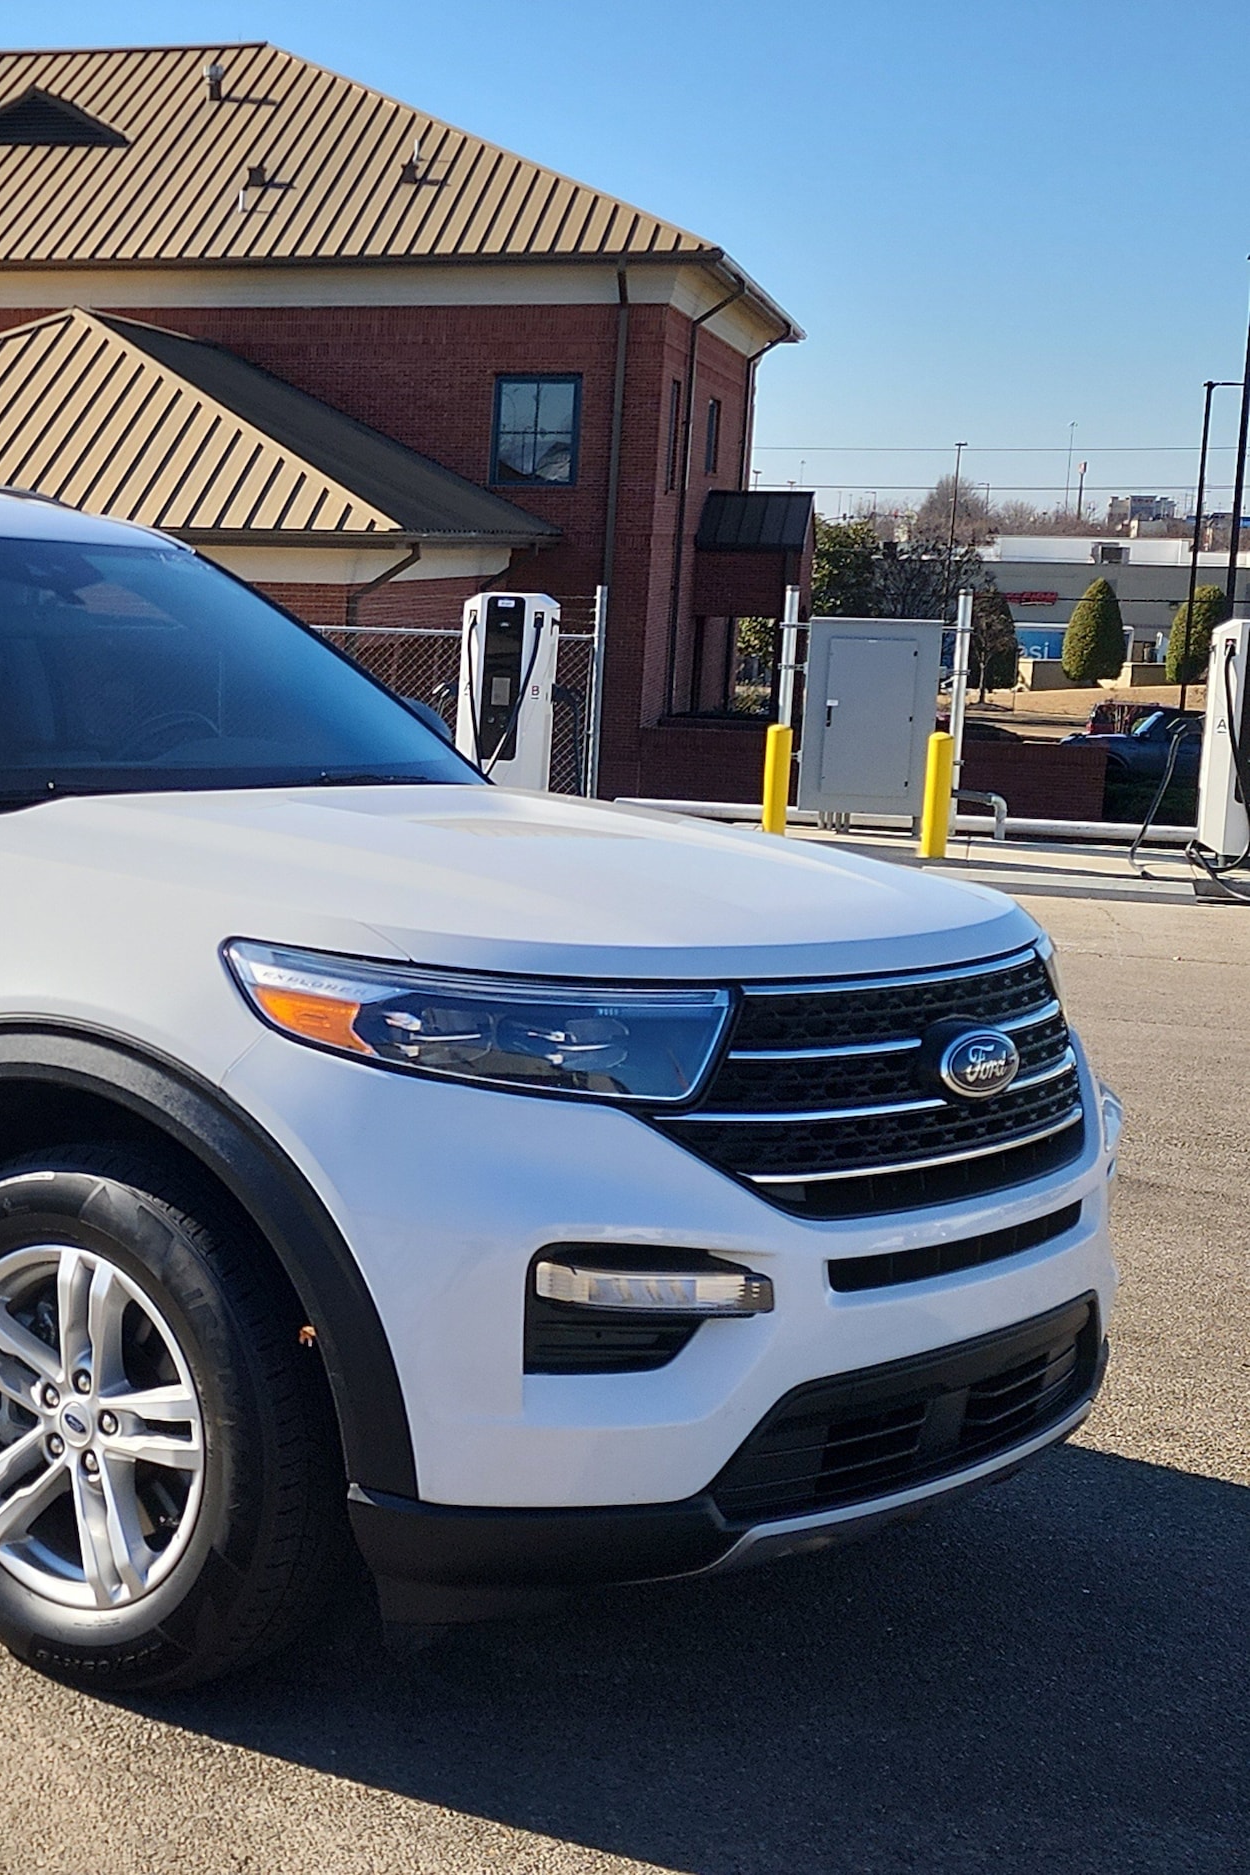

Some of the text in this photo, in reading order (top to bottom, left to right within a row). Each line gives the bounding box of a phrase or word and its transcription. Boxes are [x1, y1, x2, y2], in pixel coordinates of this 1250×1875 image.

[531, 685, 540, 696] B
[1216, 718, 1227, 730] A
[262, 970, 368, 996] EXPLORER
[961, 1044, 1008, 1083] Ford
